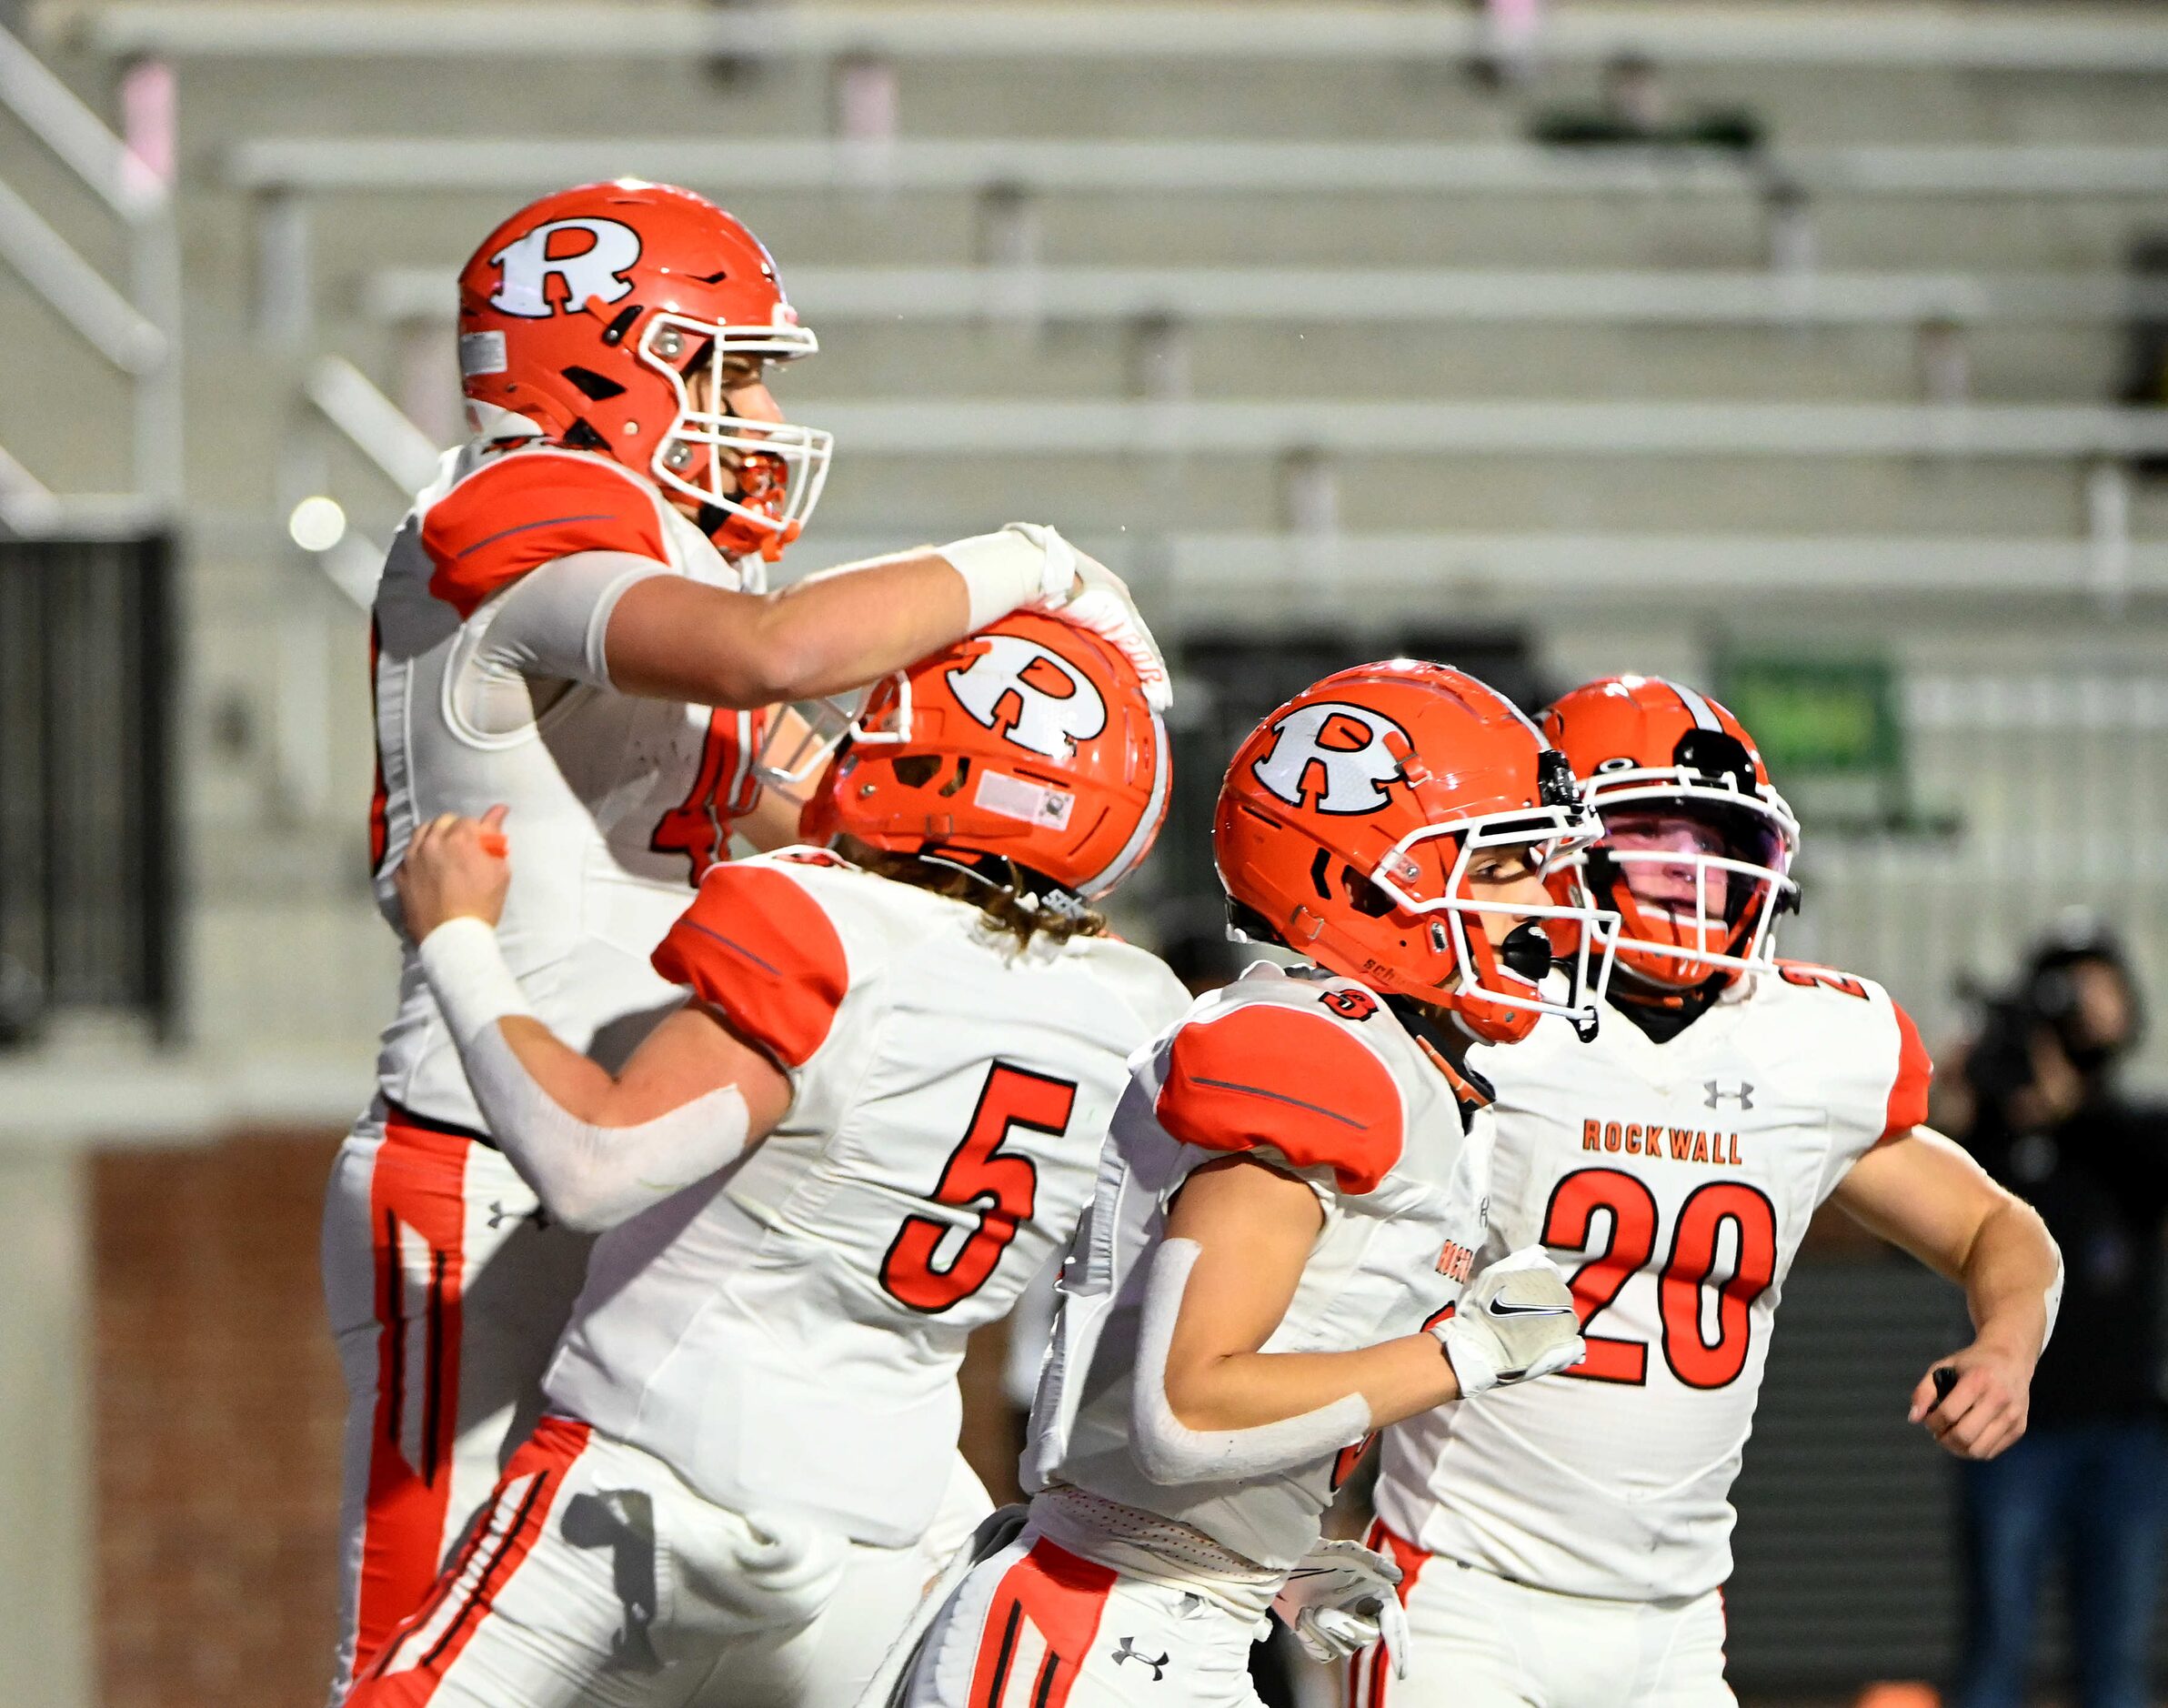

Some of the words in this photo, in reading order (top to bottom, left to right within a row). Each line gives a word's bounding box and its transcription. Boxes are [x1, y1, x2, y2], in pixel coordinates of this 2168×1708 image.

[489, 216, 643, 318] R
[944, 634, 1109, 758] R
[1251, 701, 1415, 816] R
[878, 1059, 1078, 1314] 5
[1582, 1119, 1742, 1165] ROCKWALL
[1540, 1167, 1777, 1390] 20
